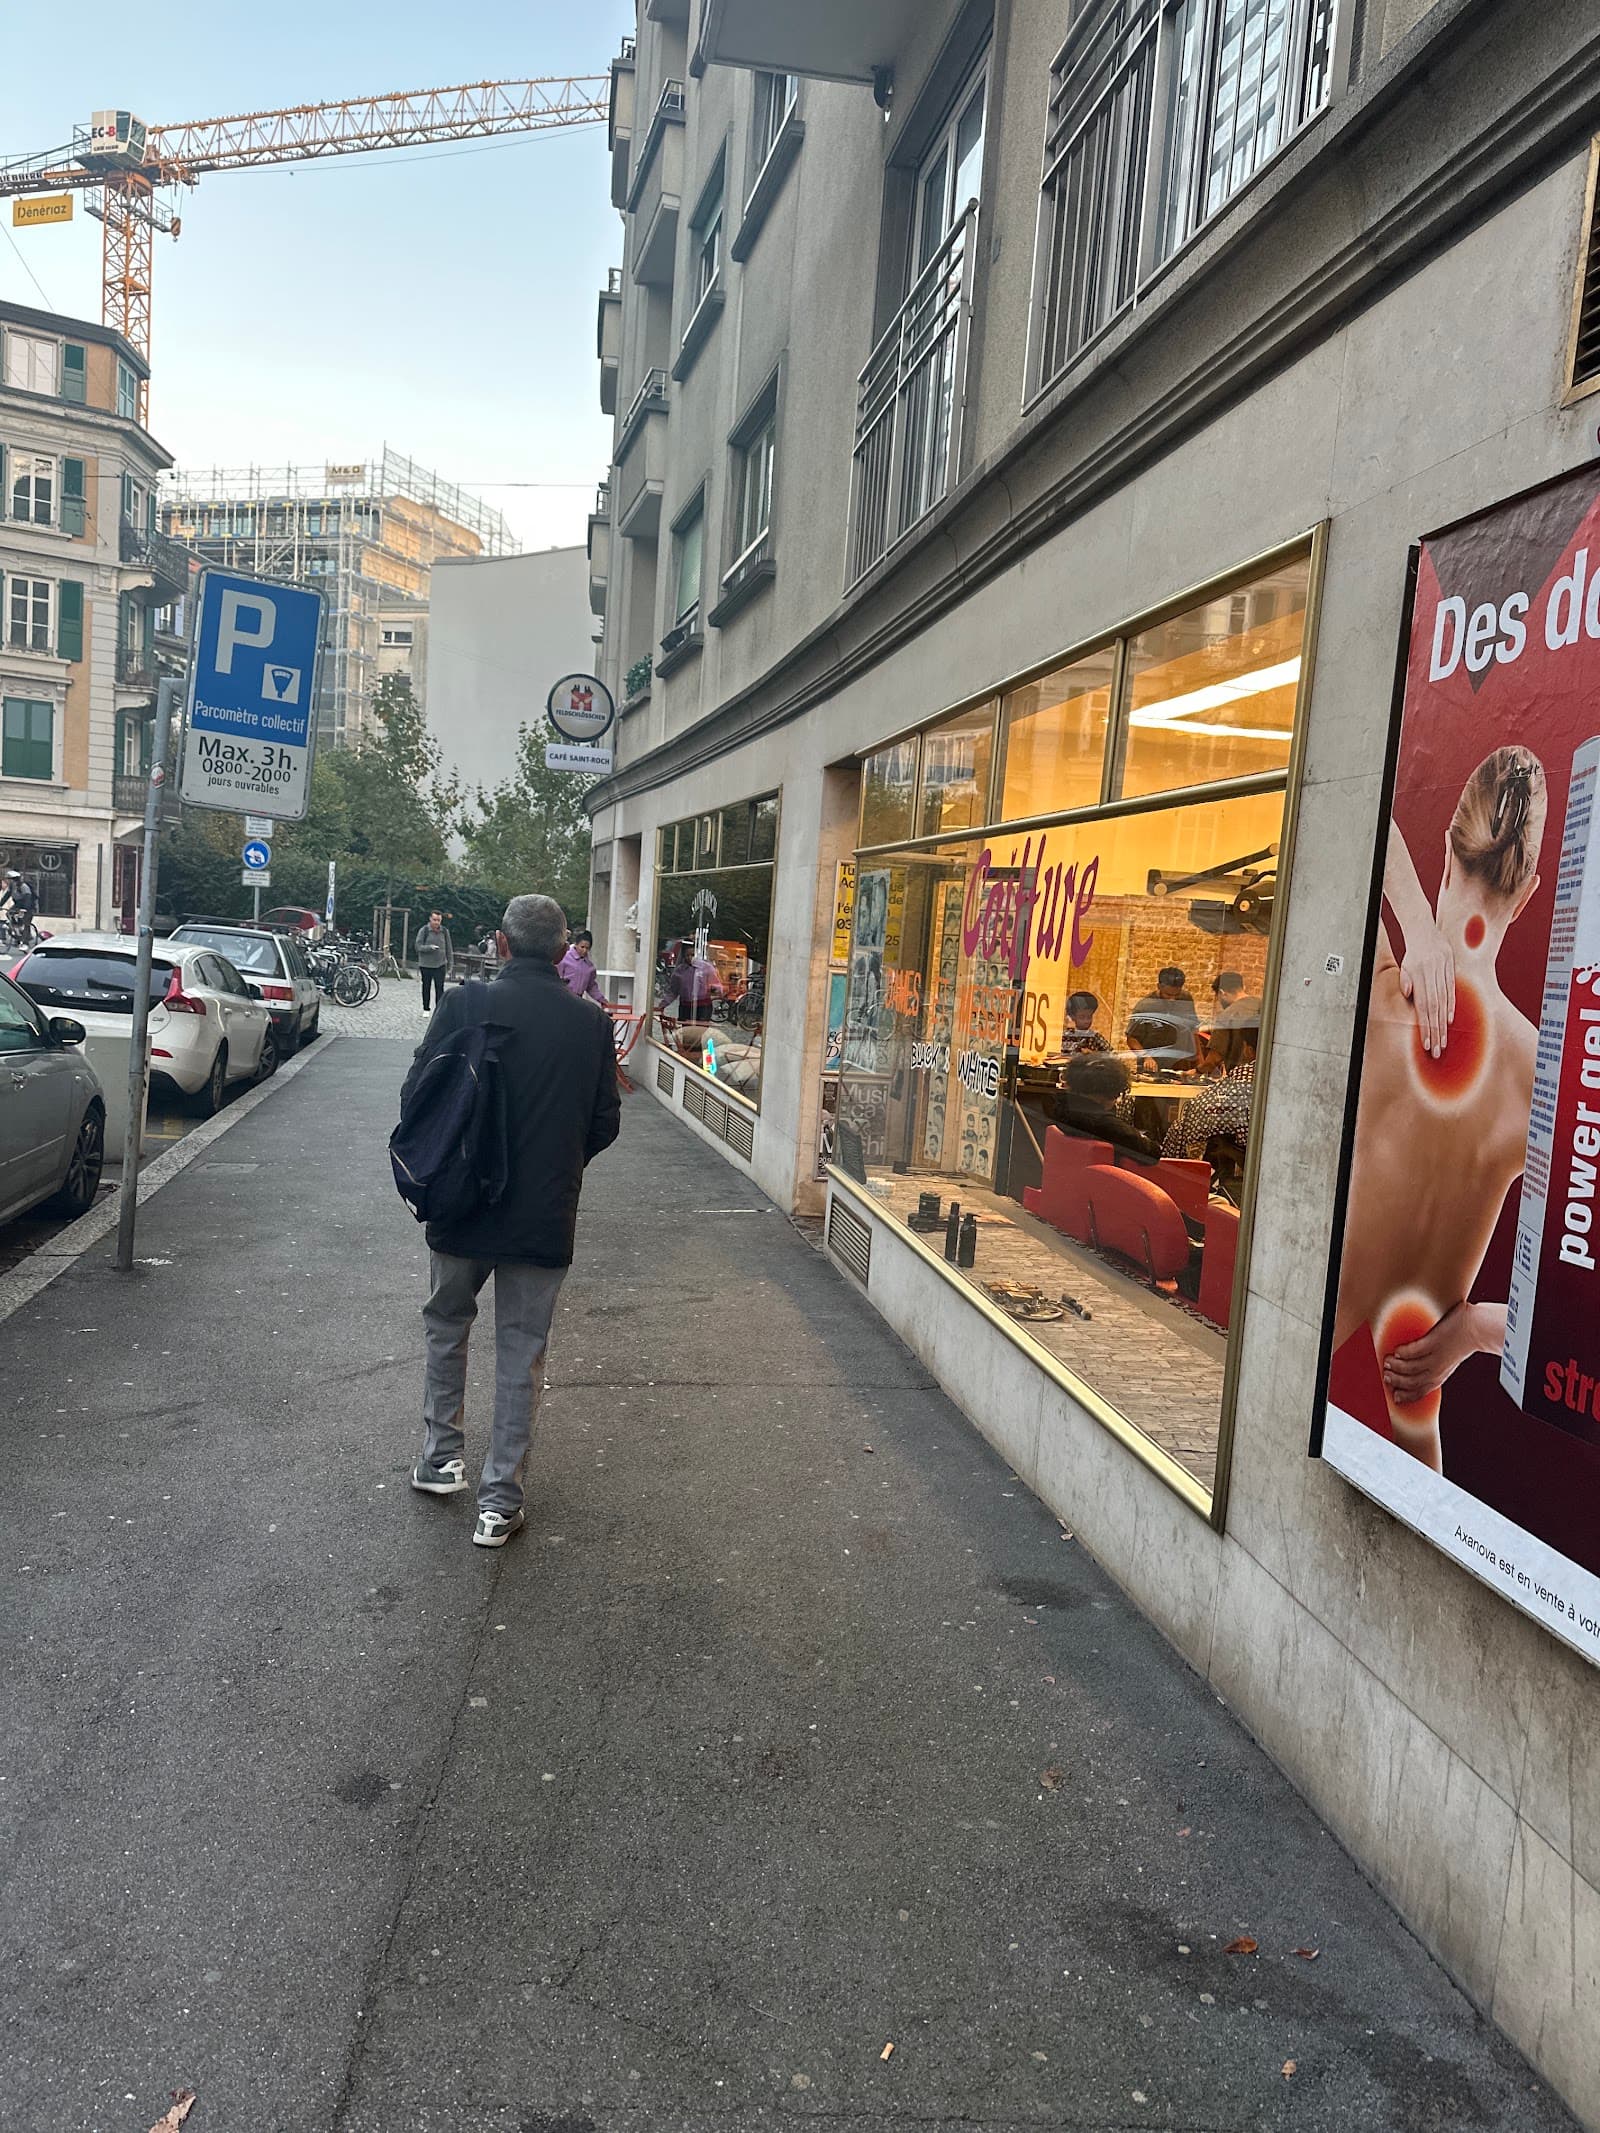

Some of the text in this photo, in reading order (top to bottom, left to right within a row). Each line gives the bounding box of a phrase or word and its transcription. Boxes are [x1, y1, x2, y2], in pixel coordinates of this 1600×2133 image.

[215, 588, 277, 675] P
[1429, 591, 1529, 683] Des
[194, 700, 305, 734] Parcomètre collectif
[198, 735, 255, 764] Max.
[207, 773, 280, 795] jours ouvrables
[549, 752, 610, 765] CAFÉ SAINT-ROCH
[963, 833, 1100, 982] Coiffure
[957, 982, 1050, 1053] MESSIEURS
[956, 1047, 1001, 1100] WHITE
[1559, 1101, 1600, 1271] power
[1543, 1358, 1600, 1423] str
[1454, 1525, 1496, 1565] Axanova
[1499, 1559, 1515, 1578] est
[1517, 1571, 1531, 1590] en
[1534, 1582, 1565, 1613] vente
[1568, 1604, 1575, 1621] à
